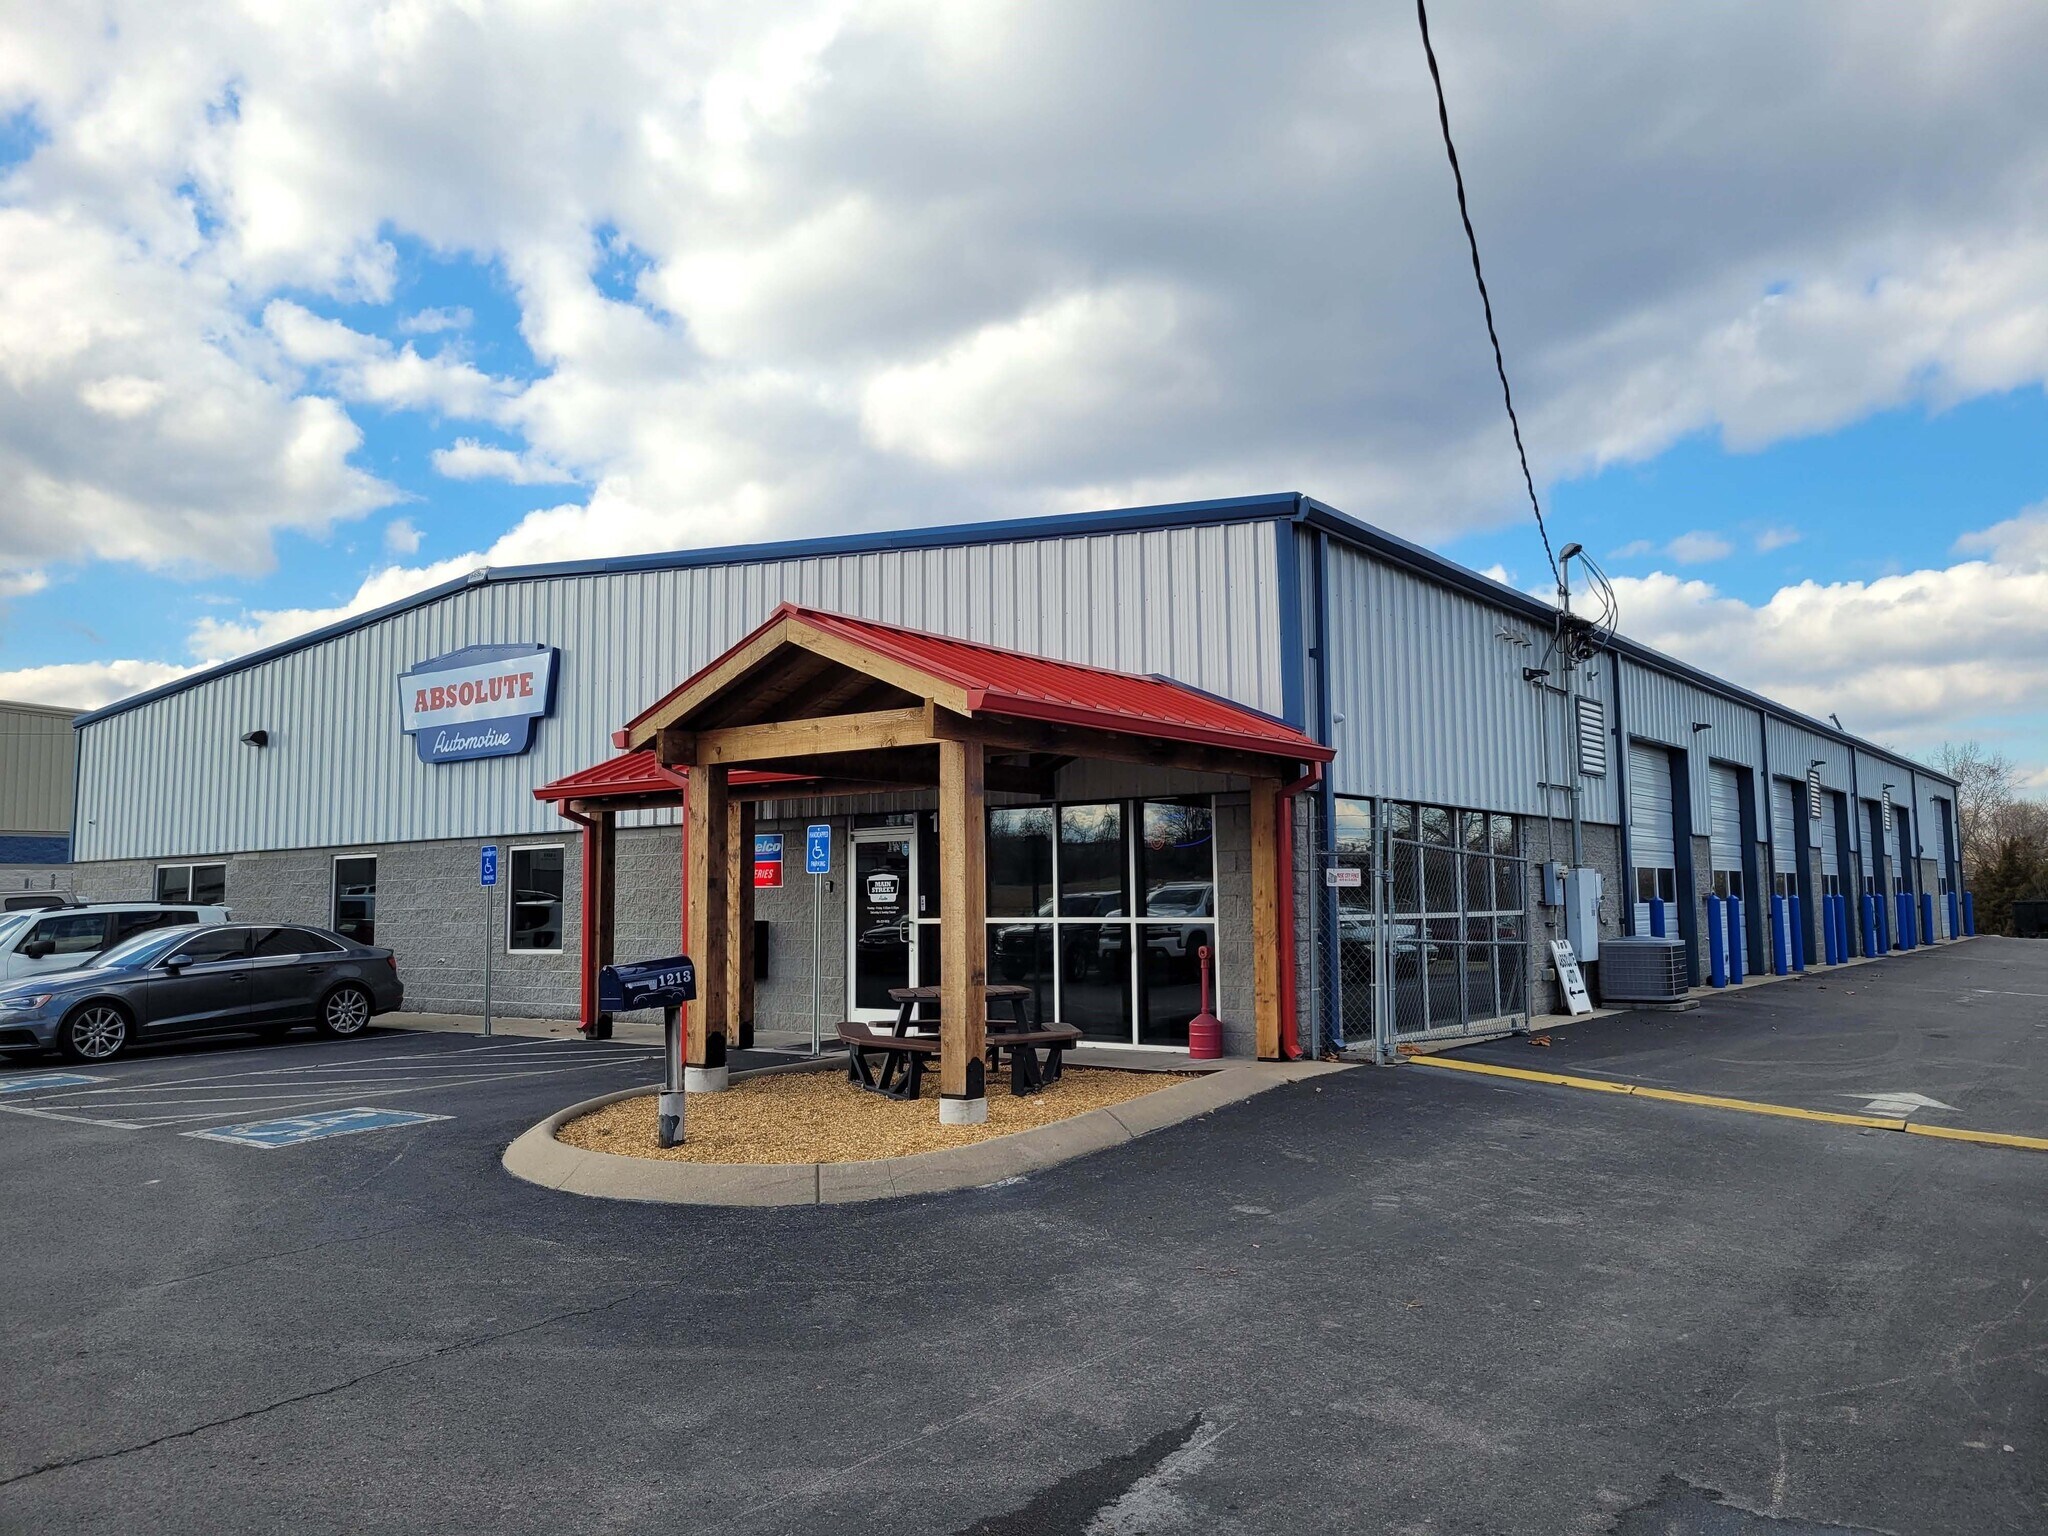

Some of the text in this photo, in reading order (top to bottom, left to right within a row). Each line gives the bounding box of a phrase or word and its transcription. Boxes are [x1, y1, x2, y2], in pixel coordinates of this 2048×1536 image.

[414, 672, 534, 713] ABSOLUTE
[433, 728, 512, 754] Automotive
[755, 840, 781, 852] elco
[755, 869, 774, 879] ERIES
[659, 970, 691, 987] 1213
